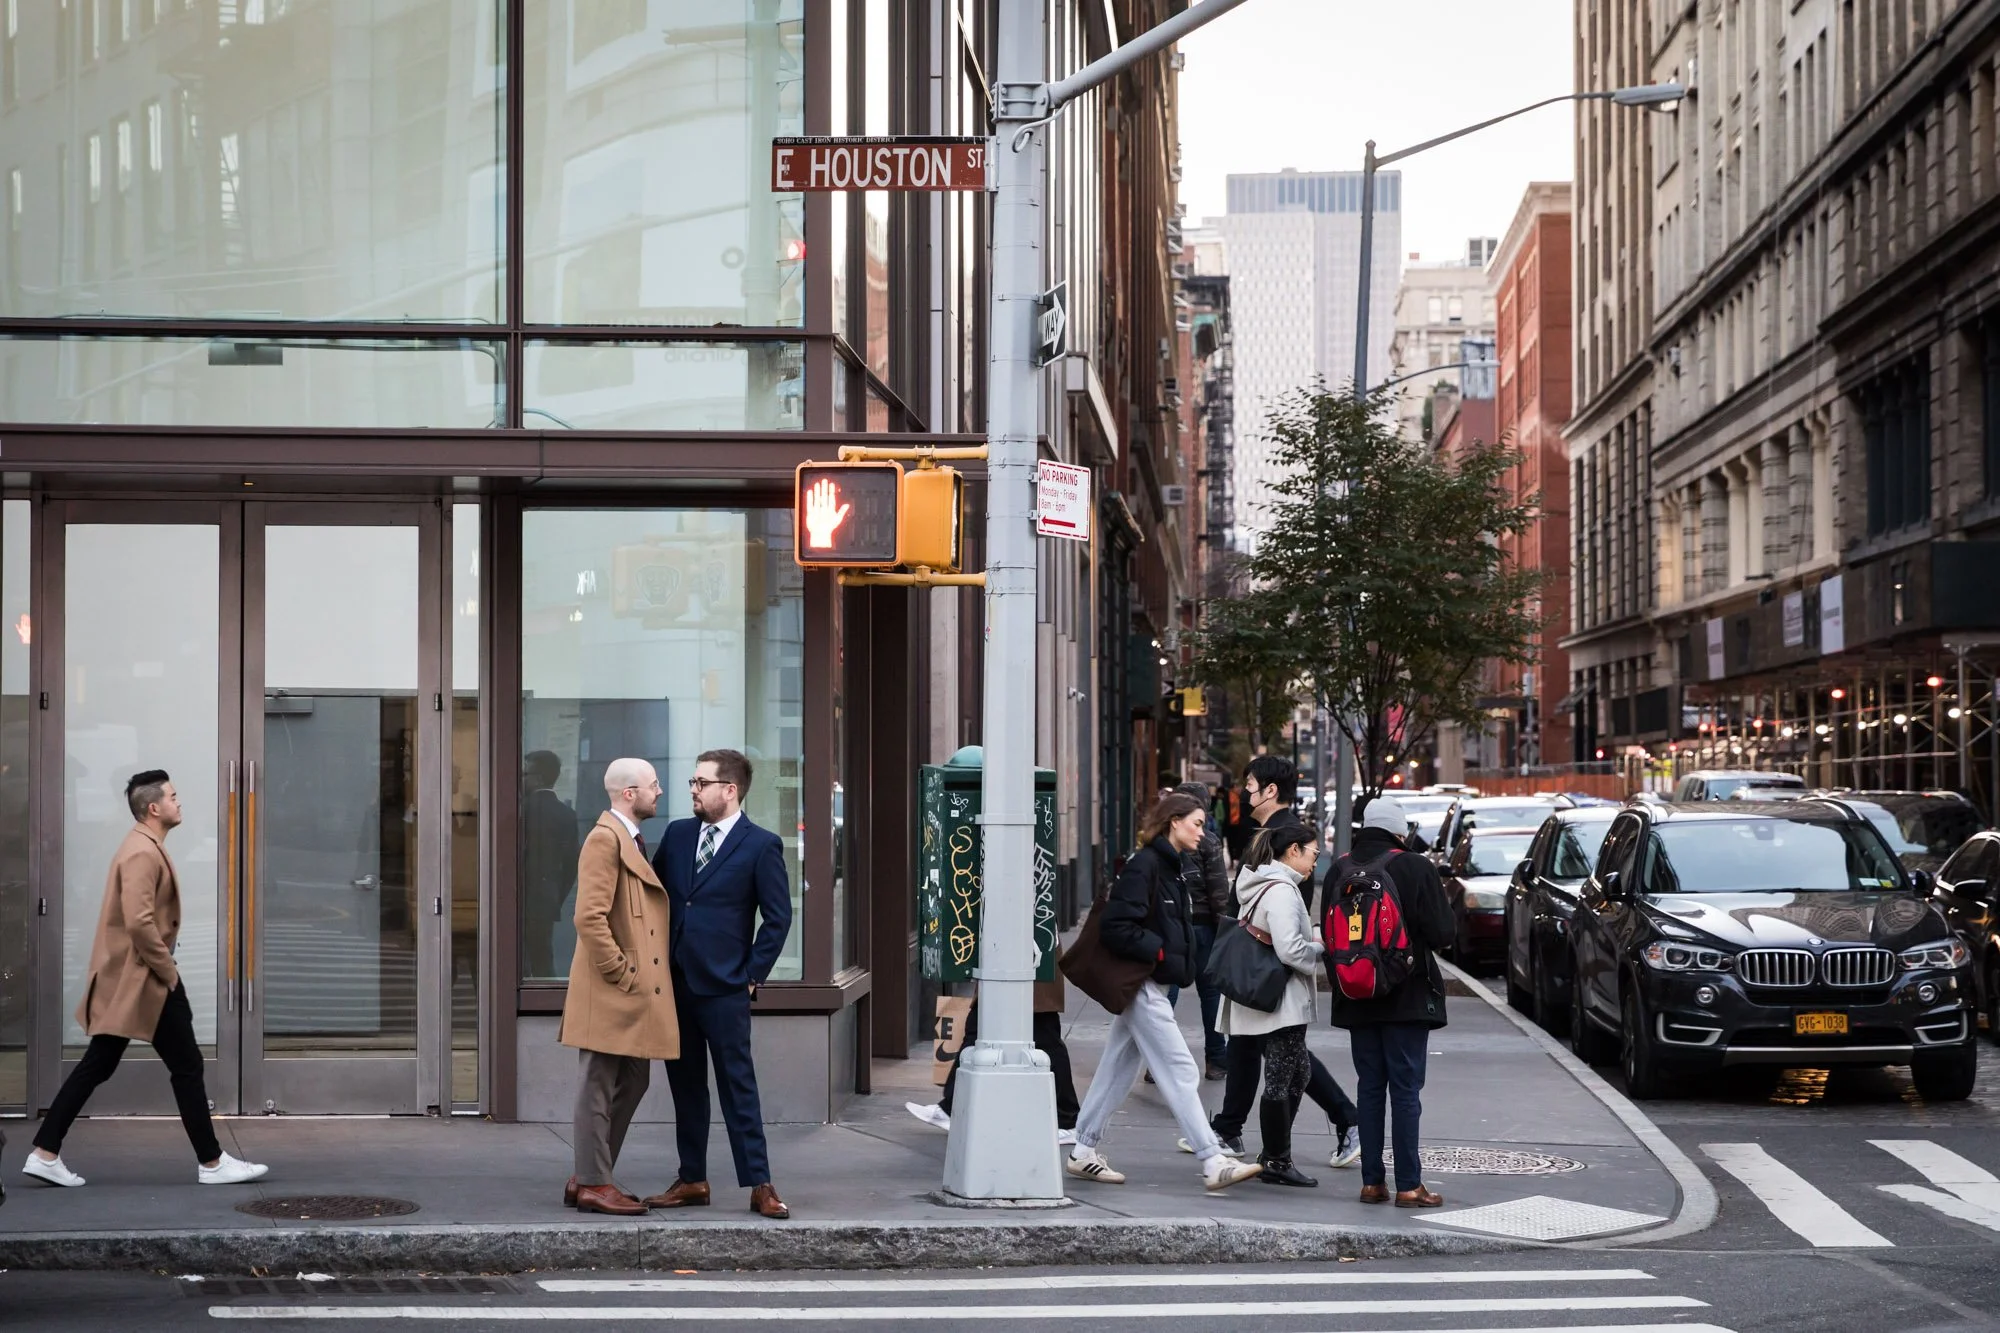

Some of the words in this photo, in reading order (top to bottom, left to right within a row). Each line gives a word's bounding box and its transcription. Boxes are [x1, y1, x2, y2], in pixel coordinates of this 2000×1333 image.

[776, 149, 794, 188] E
[810, 147, 952, 188] HOUSTON
[967, 148, 984, 169] ST
[1044, 307, 1060, 342] WAY
[1041, 468, 1051, 481] NO
[1052, 470, 1078, 486] PARKING
[1041, 485, 1059, 499] Monday
[1063, 489, 1077, 503] Friday
[1041, 498, 1051, 509] 8am
